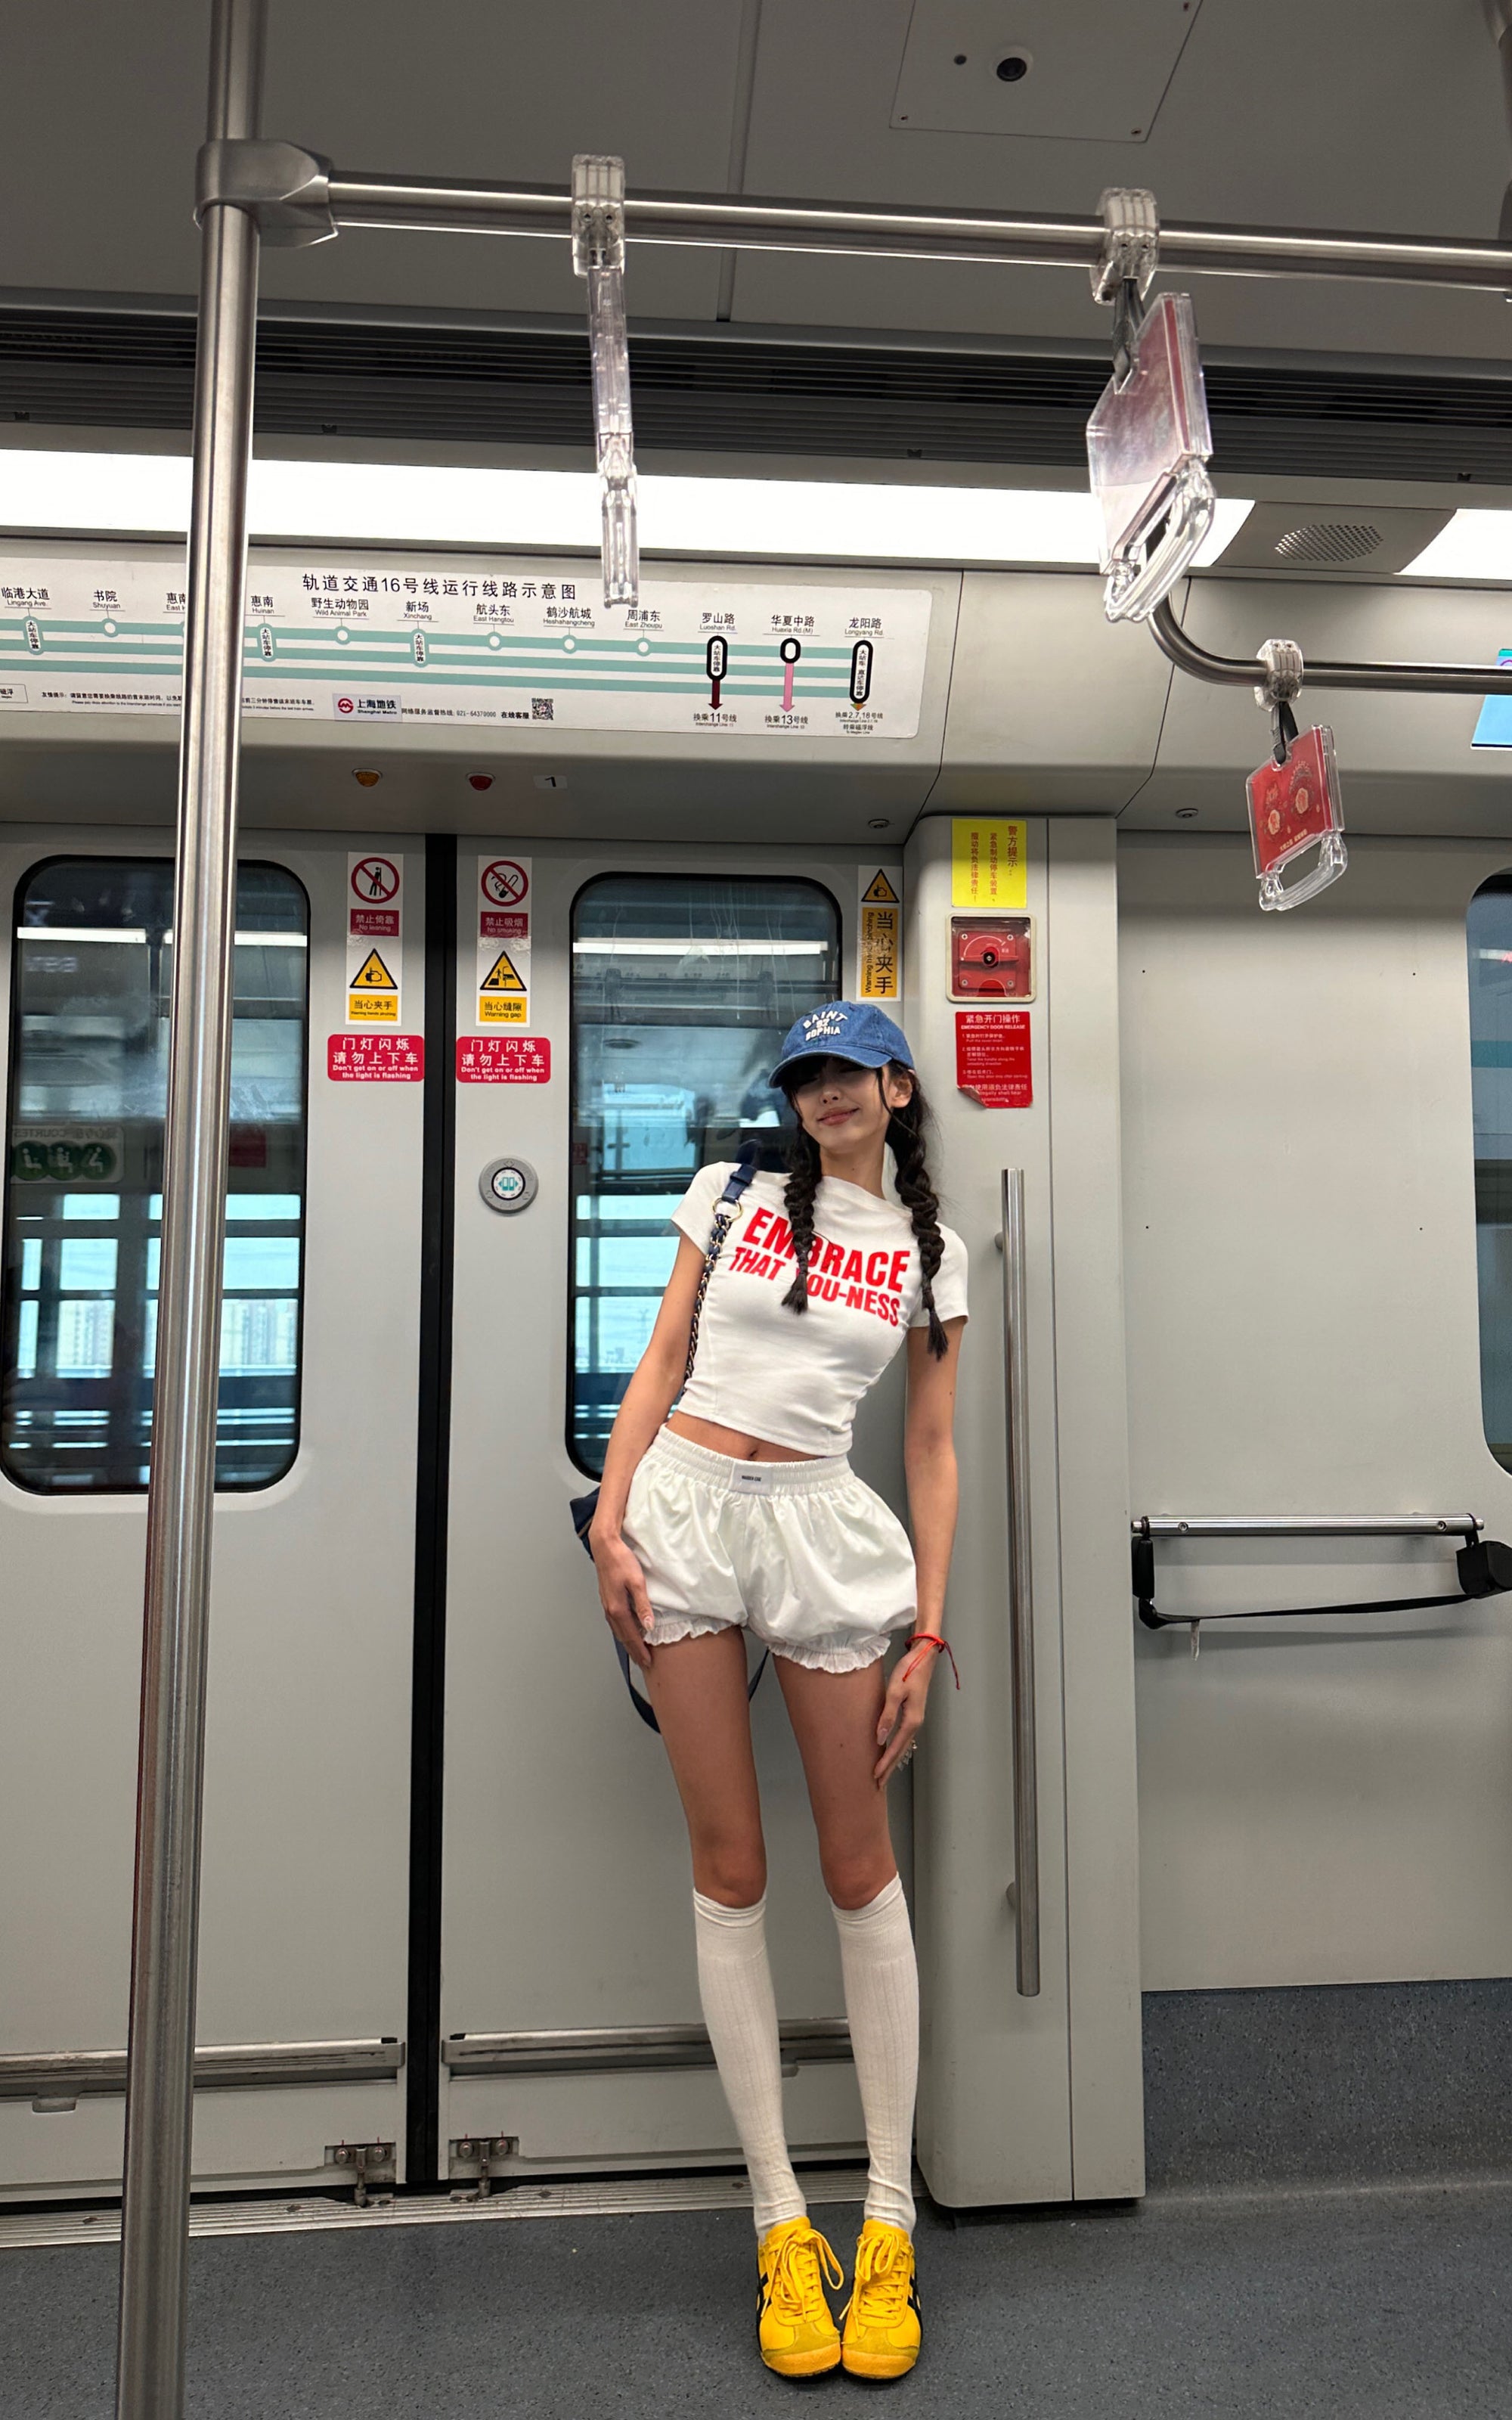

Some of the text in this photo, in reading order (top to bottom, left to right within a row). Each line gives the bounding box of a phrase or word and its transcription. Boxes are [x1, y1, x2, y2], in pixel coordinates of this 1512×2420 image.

[302, 573, 576, 600] 轨道交通16号线运行线路示意图
[2, 587, 50, 600] 临港大道
[94, 589, 117, 602] 书院
[8, 599, 33, 607] Lingang
[251, 594, 274, 608] 惠南
[311, 597, 369, 610] 野生动物园
[406, 600, 429, 613] 新场
[476, 603, 510, 616] 航头东
[547, 607, 592, 619] 鹤沙航城
[627, 609, 661, 622] 周浦东
[404, 613, 432, 621] Xinchang
[702, 612, 735, 625] 罗山路
[771, 614, 815, 627] 华夏中路
[849, 616, 881, 629] 龙阳路
[844, 628, 872, 637] Longyang
[357, 699, 397, 709] 上海地铁
[693, 712, 737, 724] 换乘11号线
[764, 714, 808, 726] 换乘13号线
[355, 914, 395, 924] 禁止倚靠
[485, 917, 523, 927] 禁止吸烟
[874, 911, 894, 994] 当心夹手
[354, 999, 393, 1010] 当心夹手
[484, 1001, 522, 1012] 当心缝隙
[803, 1010, 848, 1029] SAINT
[965, 1013, 1021, 1023] 紧急开门操作
[805, 1025, 841, 1041] SOPHIA
[342, 1037, 410, 1050] 门灯闪烁
[470, 1038, 536, 1053] 门灯闪烁
[333, 1051, 418, 1065] 请勿上下车
[461, 1053, 545, 1067] 请勿上下车
[728, 1246, 900, 1327] THAT OU-NESS
